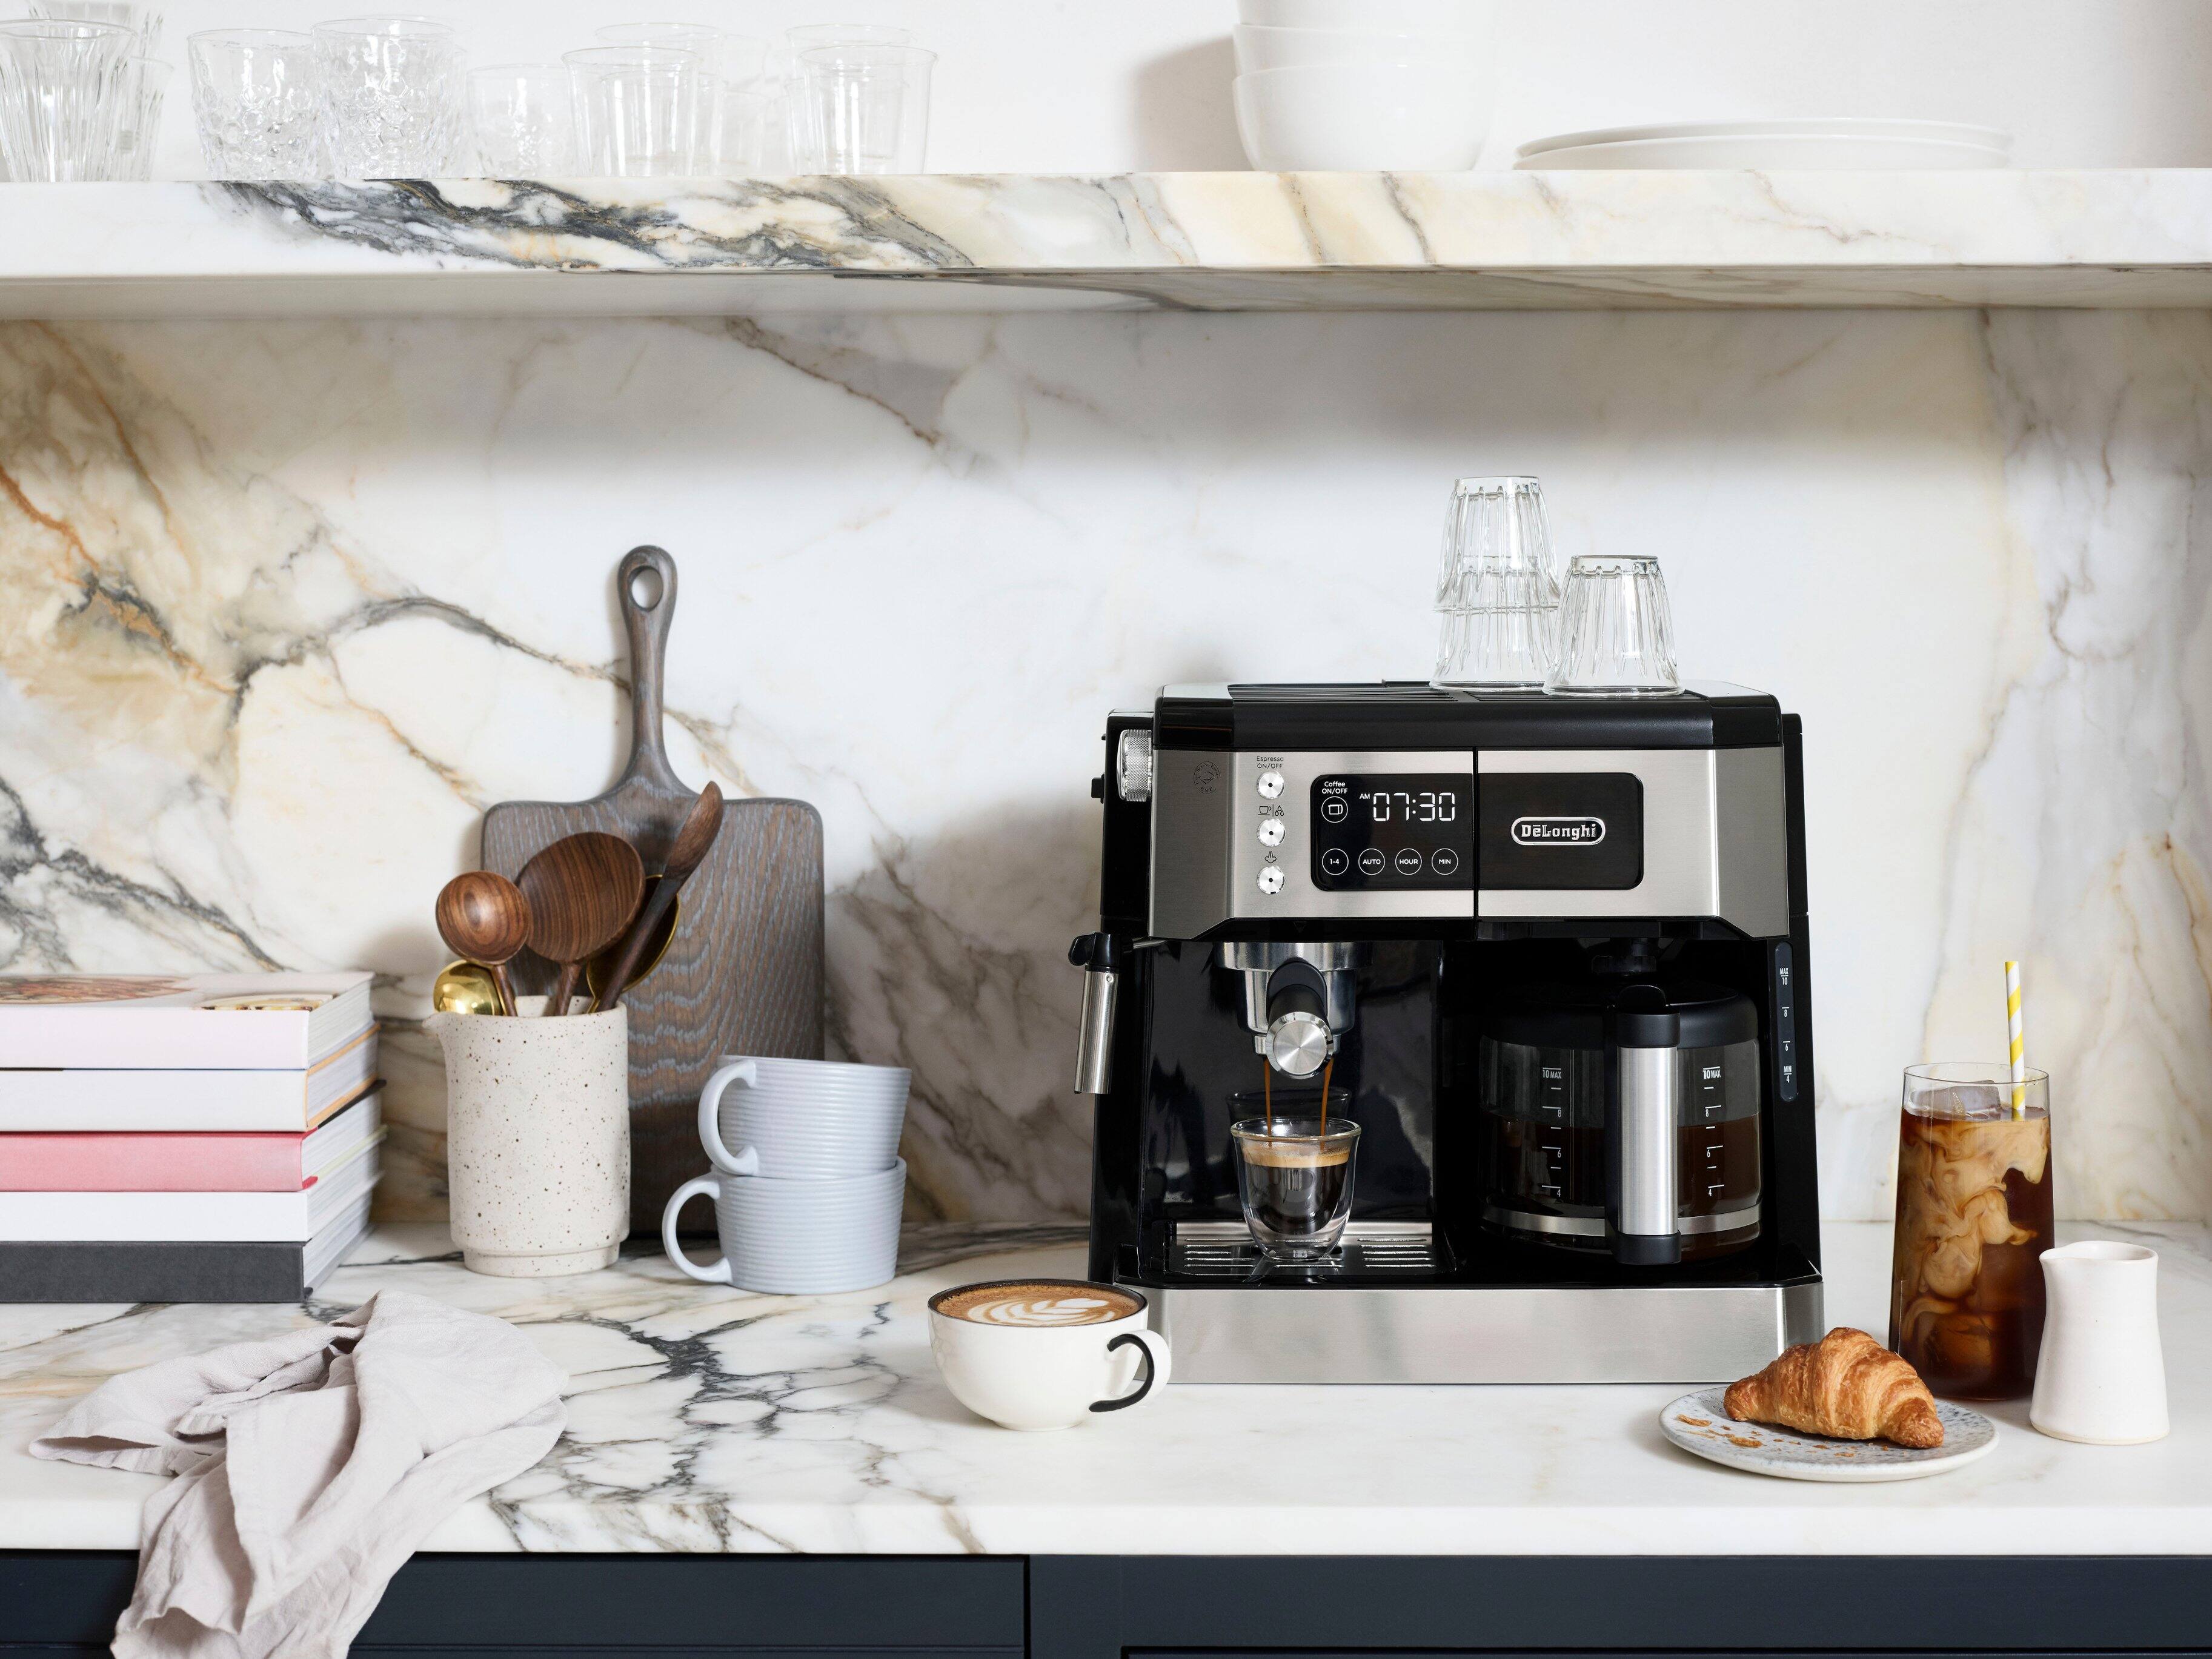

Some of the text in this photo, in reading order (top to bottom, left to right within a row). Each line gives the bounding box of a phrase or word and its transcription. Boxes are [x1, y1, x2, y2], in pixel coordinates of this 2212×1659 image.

[1373, 792, 1455, 821] 07:30
[1782, 977, 1788, 985] 10
[1784, 1009, 1787, 1018] 8
[1785, 1043, 1789, 1051] 6
[1543, 1069, 1549, 1078] 10
[1702, 1069, 1721, 1079] 10 MAX
[1786, 1075, 1790, 1083] 4
[1557, 1109, 1562, 1118] 8
[1705, 1108, 1709, 1118] 8
[1557, 1150, 1561, 1158] 6
[1707, 1149, 1711, 1158] 6
[1556, 1188, 1561, 1197] 4
[1708, 1188, 1712, 1197] 4
